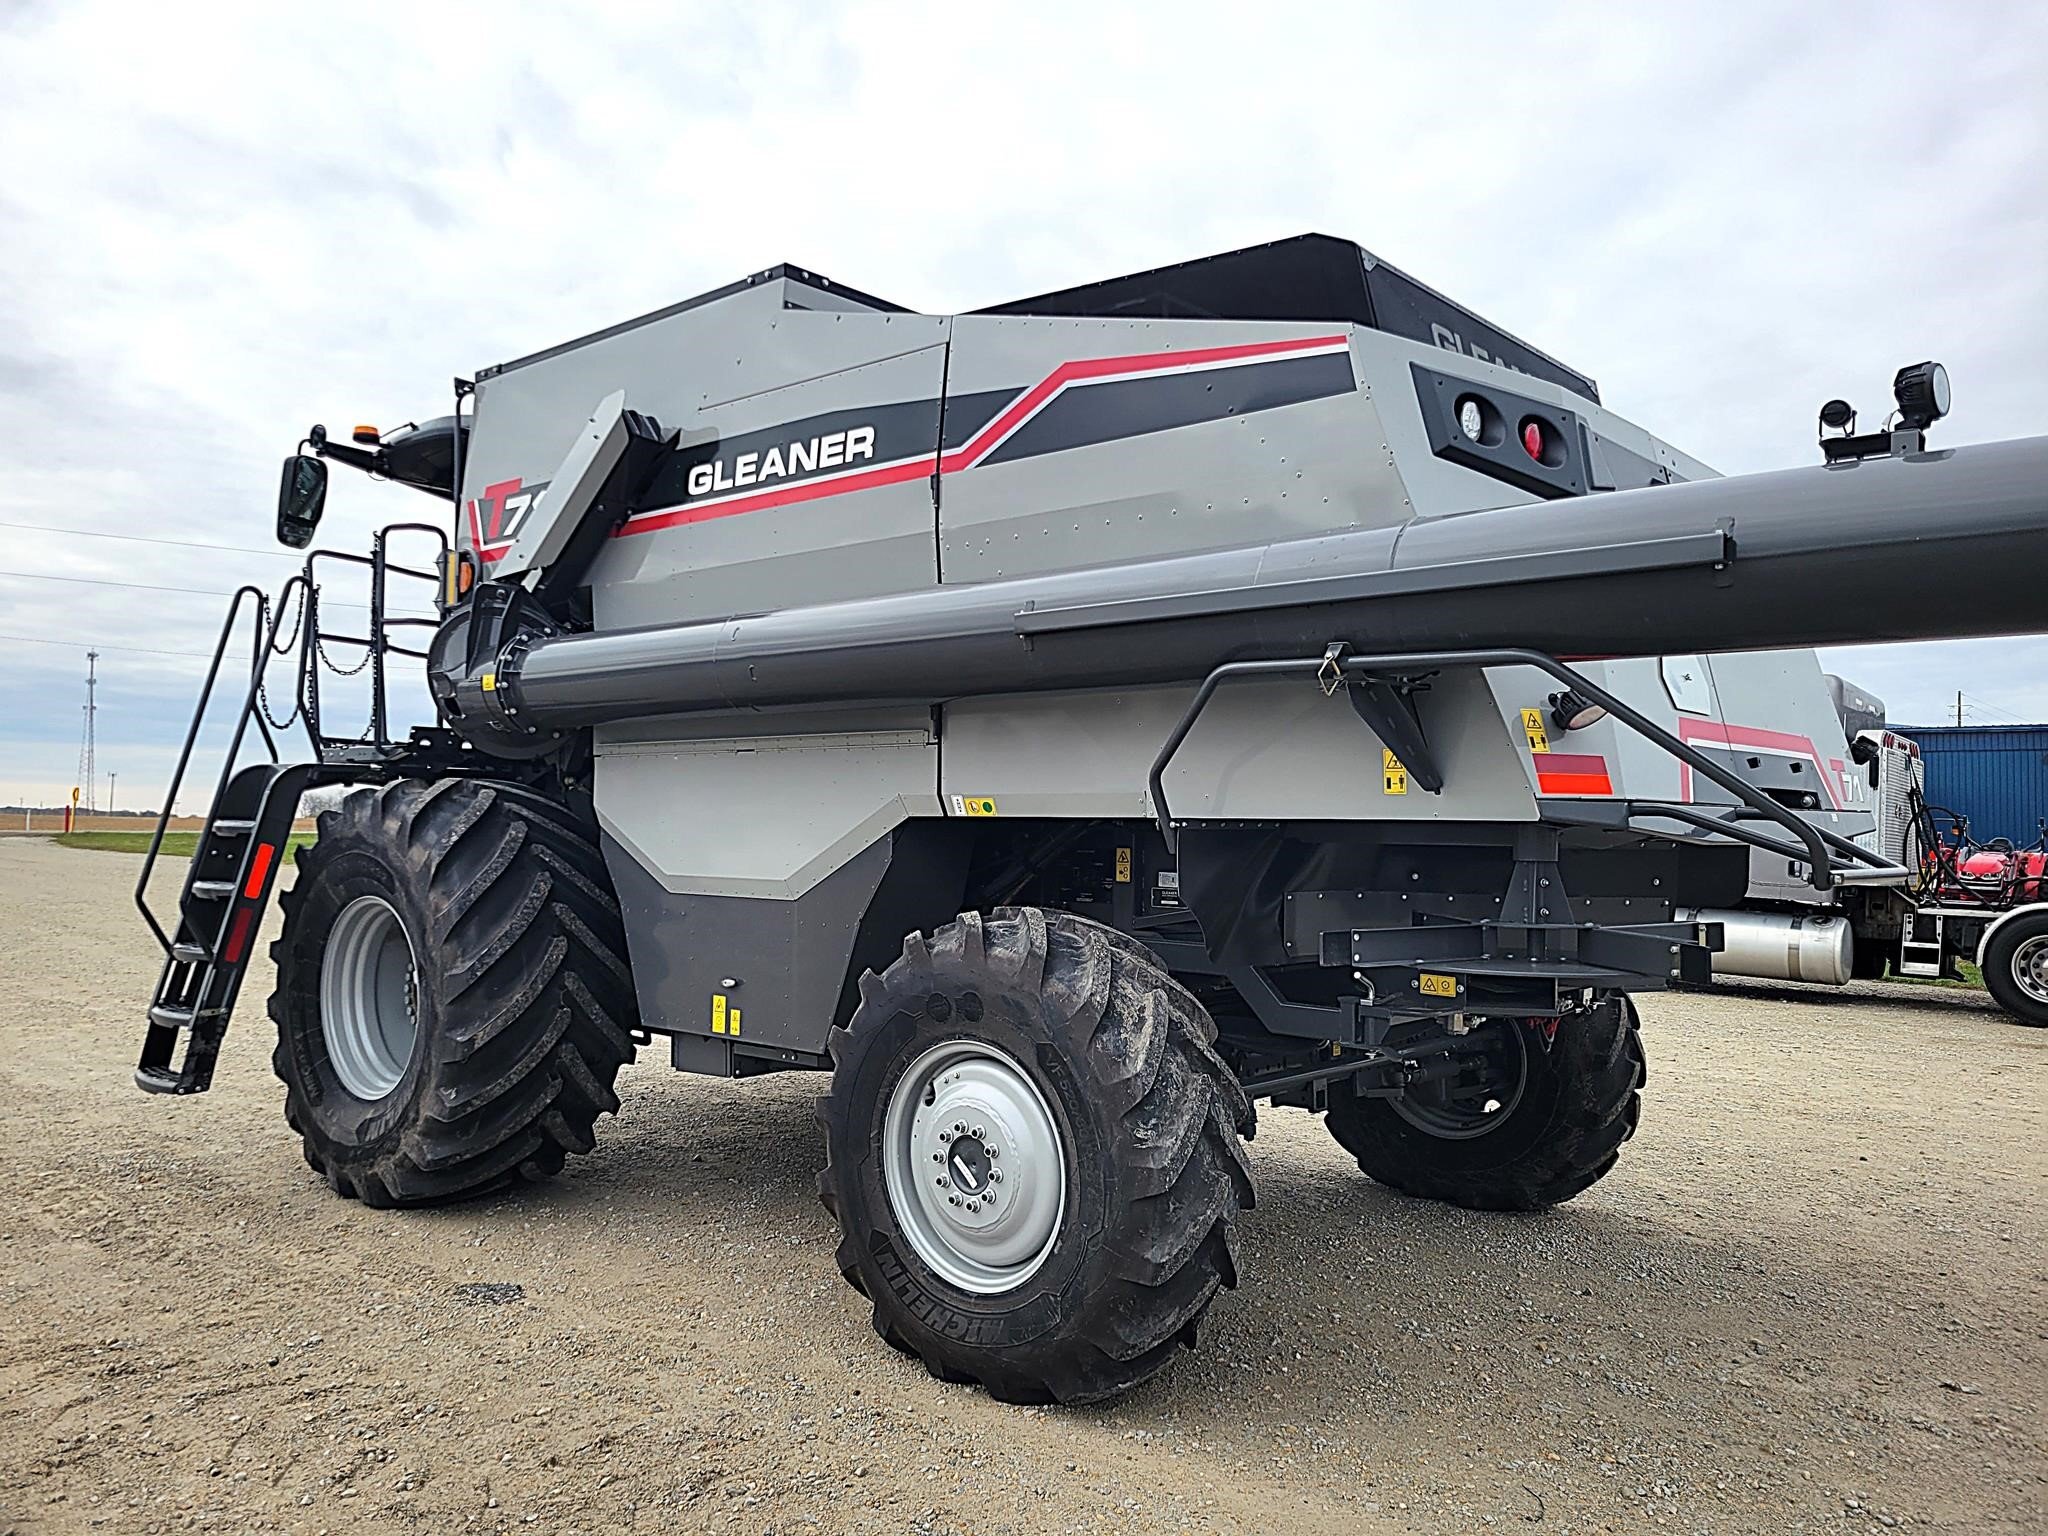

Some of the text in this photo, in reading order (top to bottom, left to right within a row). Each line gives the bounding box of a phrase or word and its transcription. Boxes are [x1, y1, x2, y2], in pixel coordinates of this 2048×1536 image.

[688, 426, 875, 496] GLEANER
[484, 477, 548, 539] T7
[1829, 759, 1865, 803] T71
[873, 1251, 1005, 1344] MICHELIN
